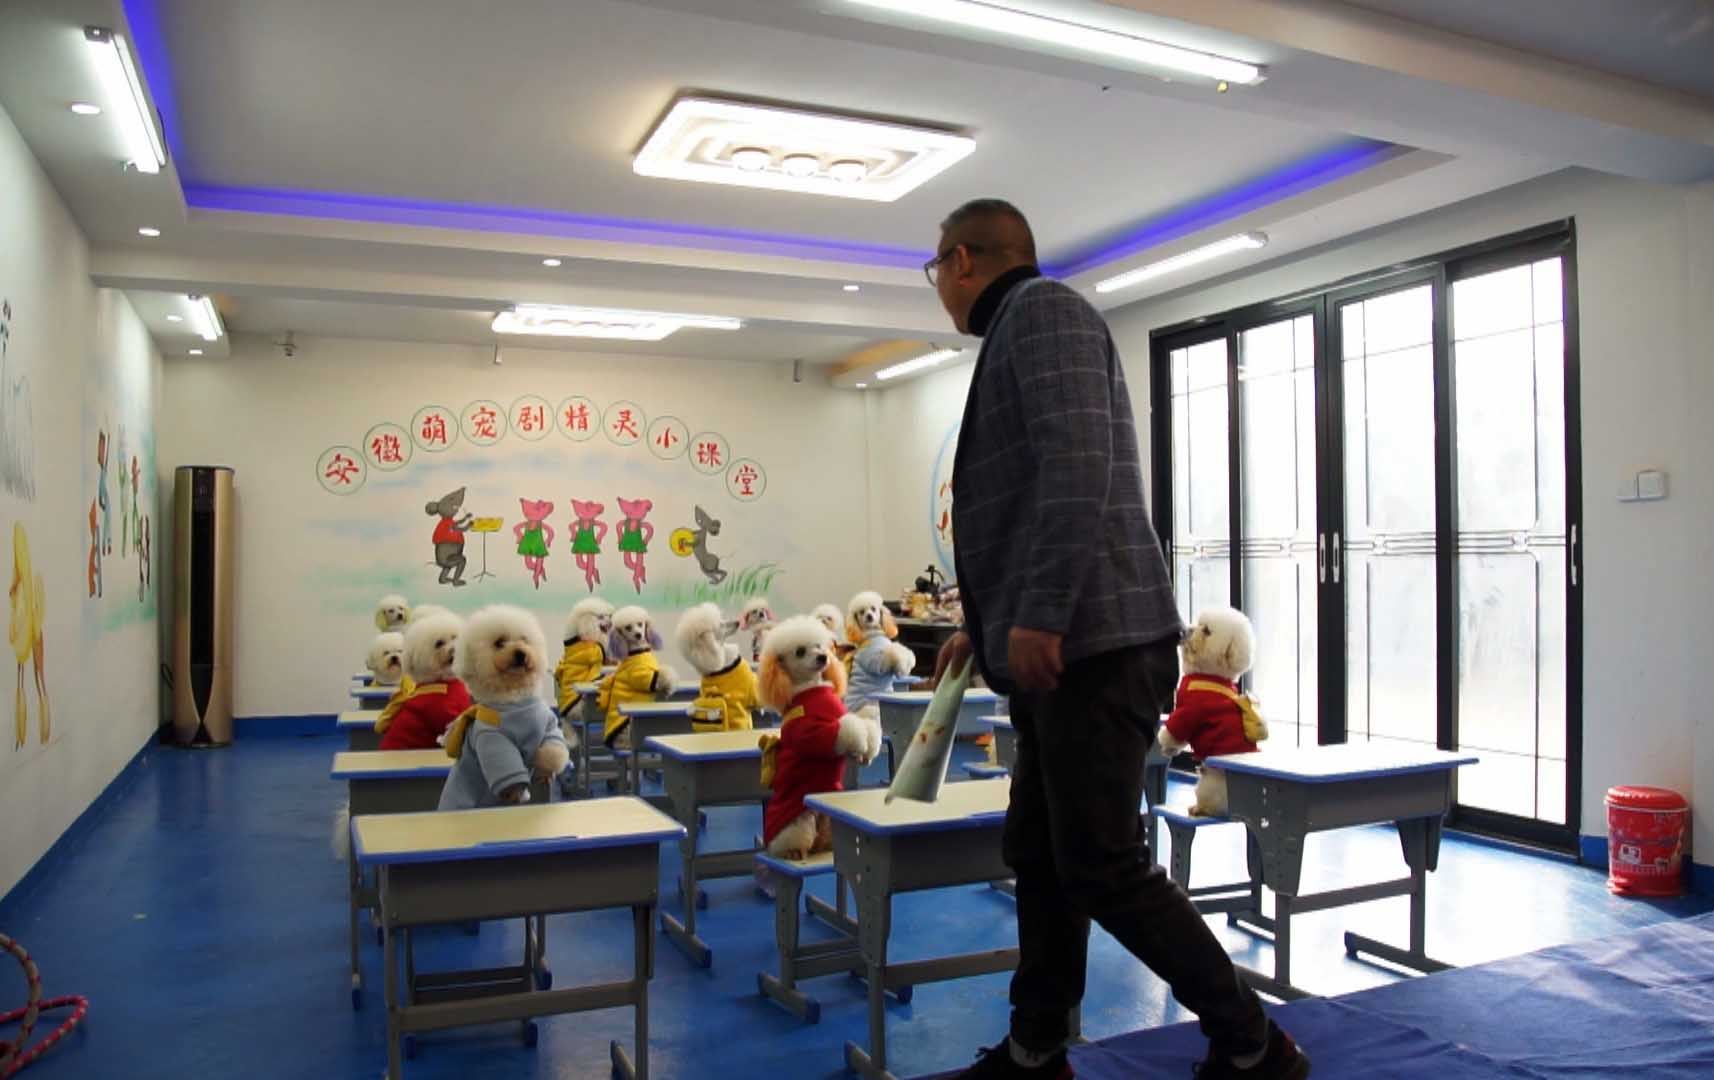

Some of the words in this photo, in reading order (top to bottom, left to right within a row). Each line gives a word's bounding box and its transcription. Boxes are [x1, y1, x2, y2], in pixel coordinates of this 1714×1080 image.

[325, 403, 758, 496] 安徽萌宠剧精灵小课堂
